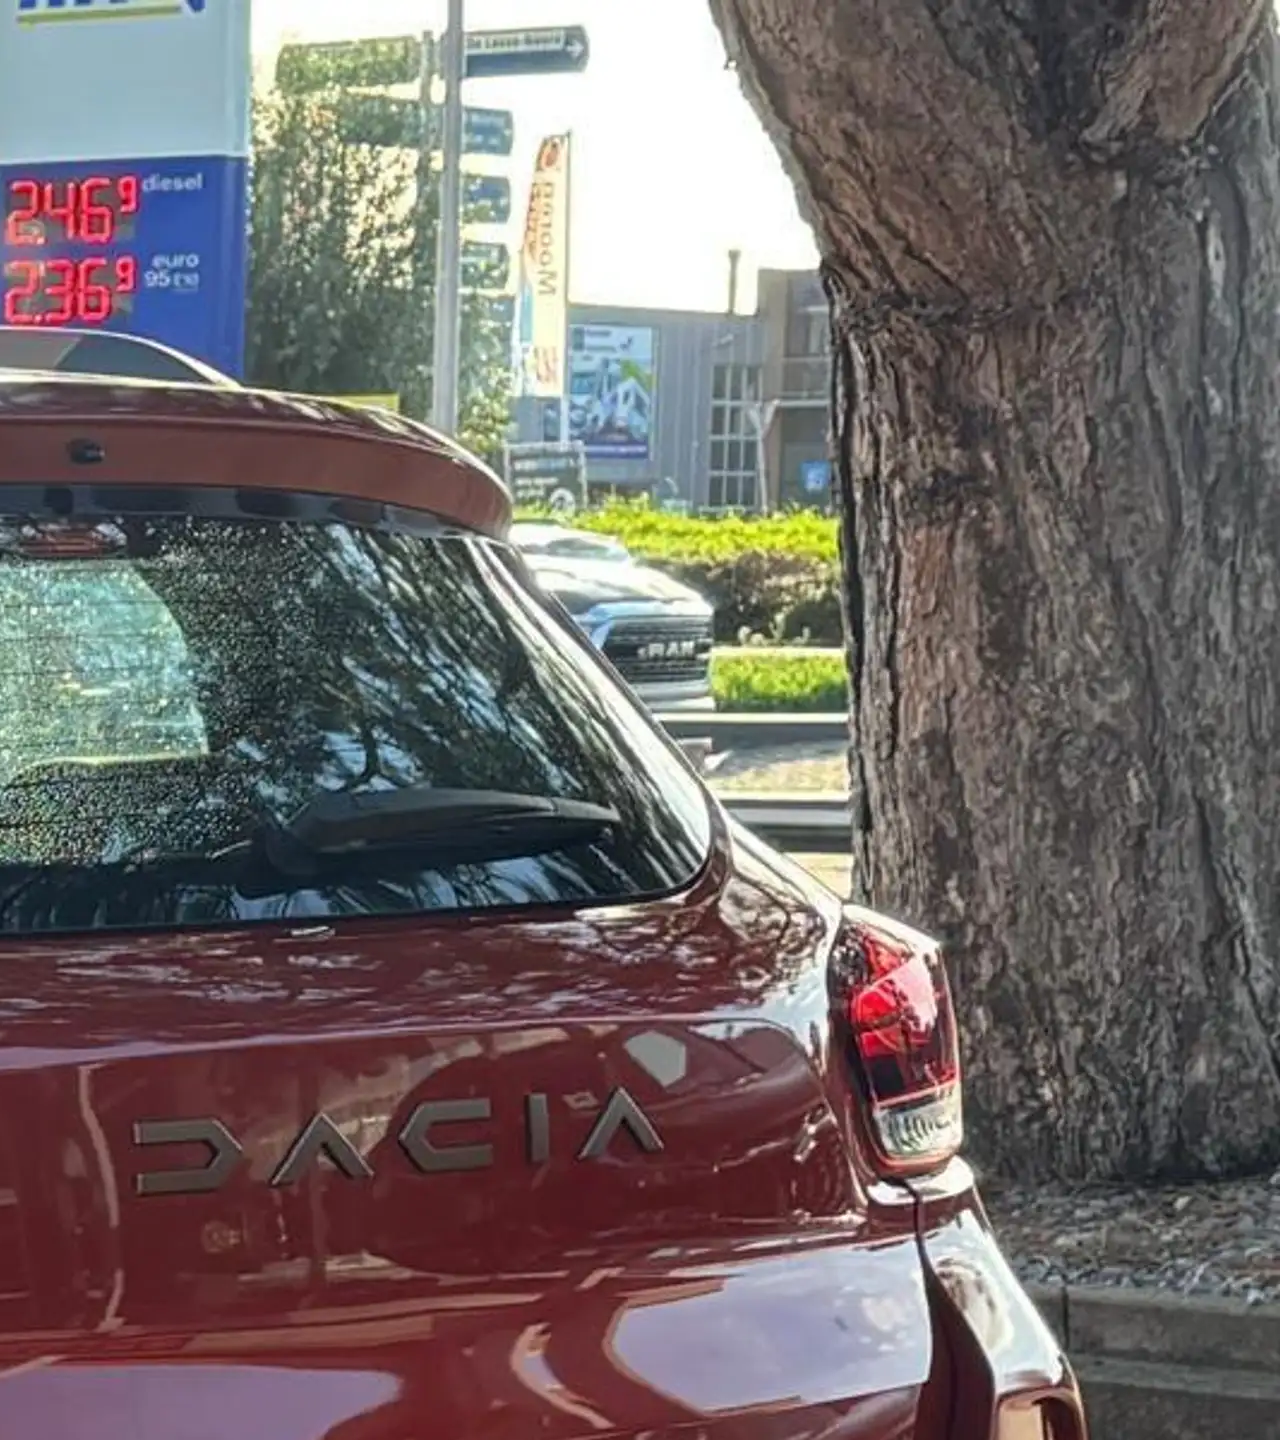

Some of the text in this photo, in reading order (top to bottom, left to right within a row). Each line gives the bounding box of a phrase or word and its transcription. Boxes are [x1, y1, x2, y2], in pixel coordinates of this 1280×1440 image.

[143, 173, 203, 191] diesel
[151, 253, 200, 268] euro
[143, 270, 171, 288] 95
[135, 1087, 665, 1193] DACIA
